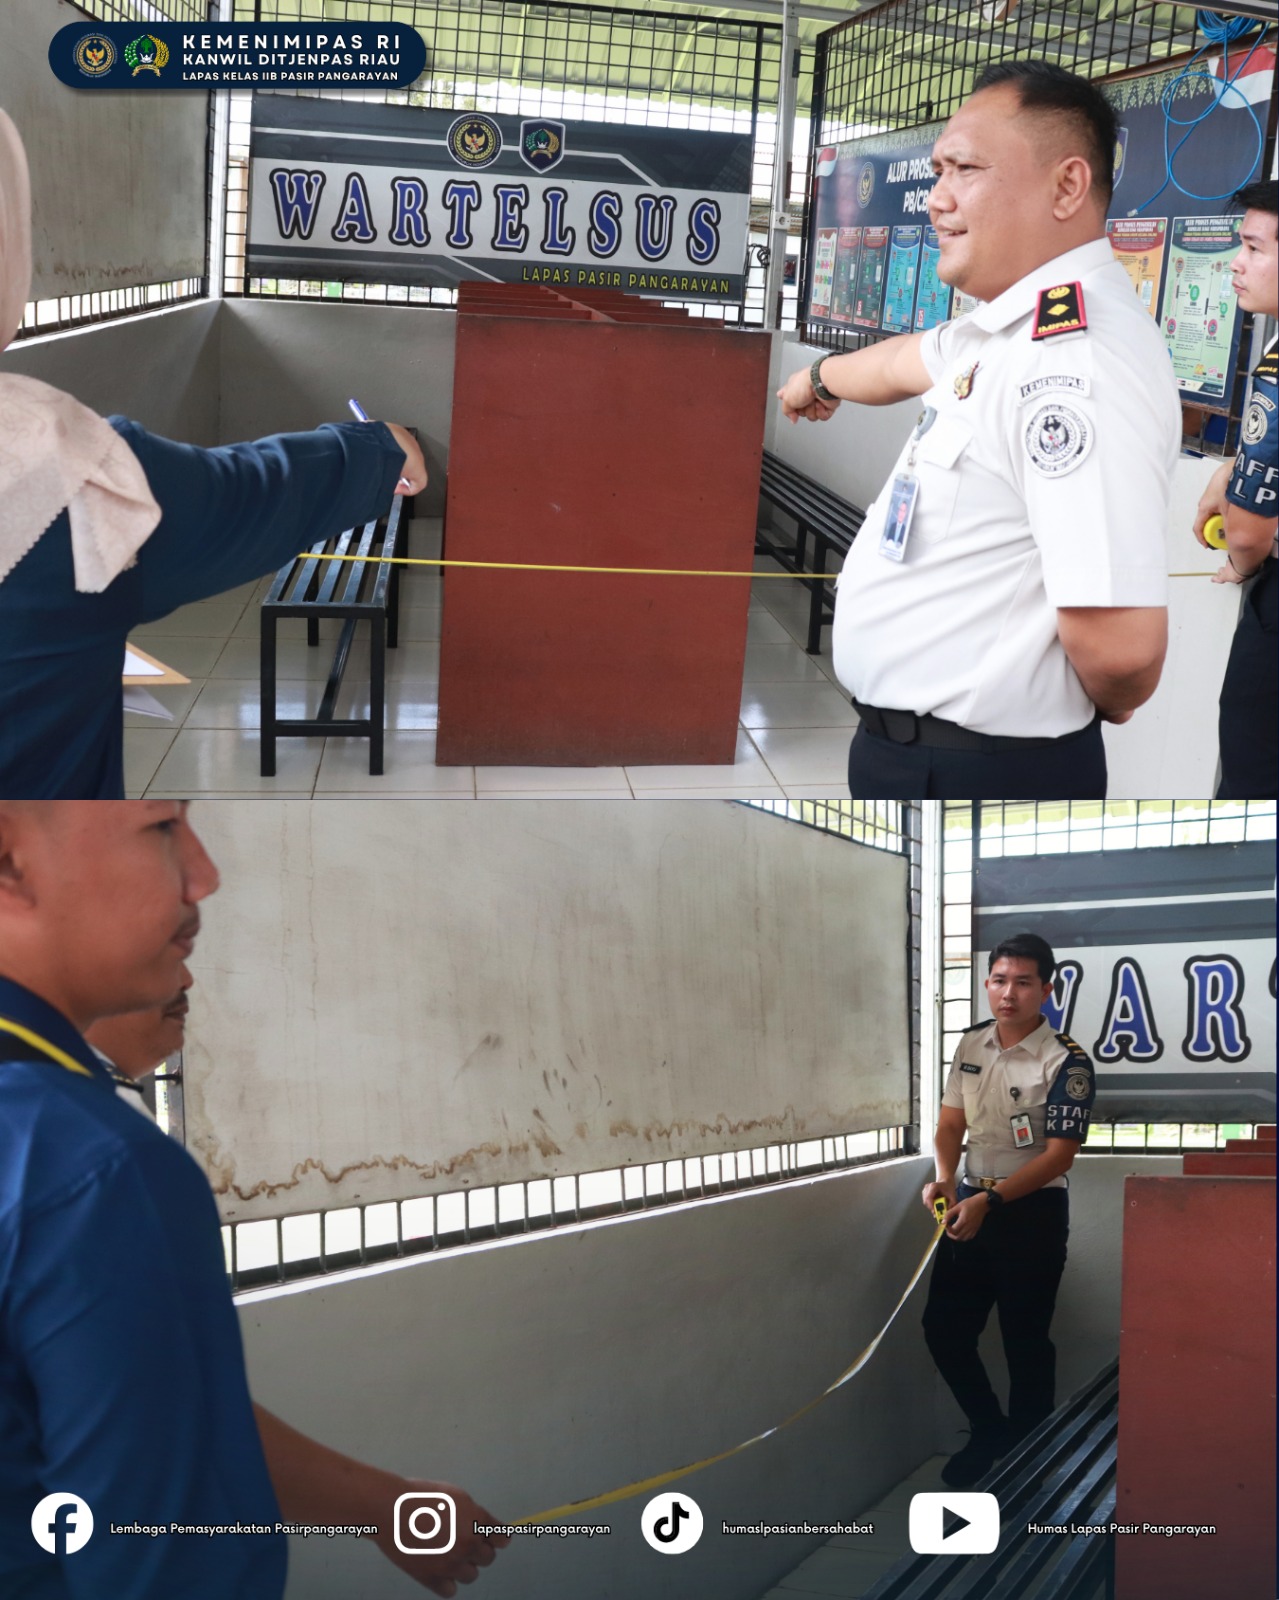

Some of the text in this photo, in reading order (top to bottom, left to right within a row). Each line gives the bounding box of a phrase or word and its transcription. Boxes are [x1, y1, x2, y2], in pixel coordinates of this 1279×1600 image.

[886, 160, 908, 184] ALUR
[269, 168, 722, 266] WARTELSUS
[522, 267, 729, 294] LAPAS PASIR PANGARAYAN
